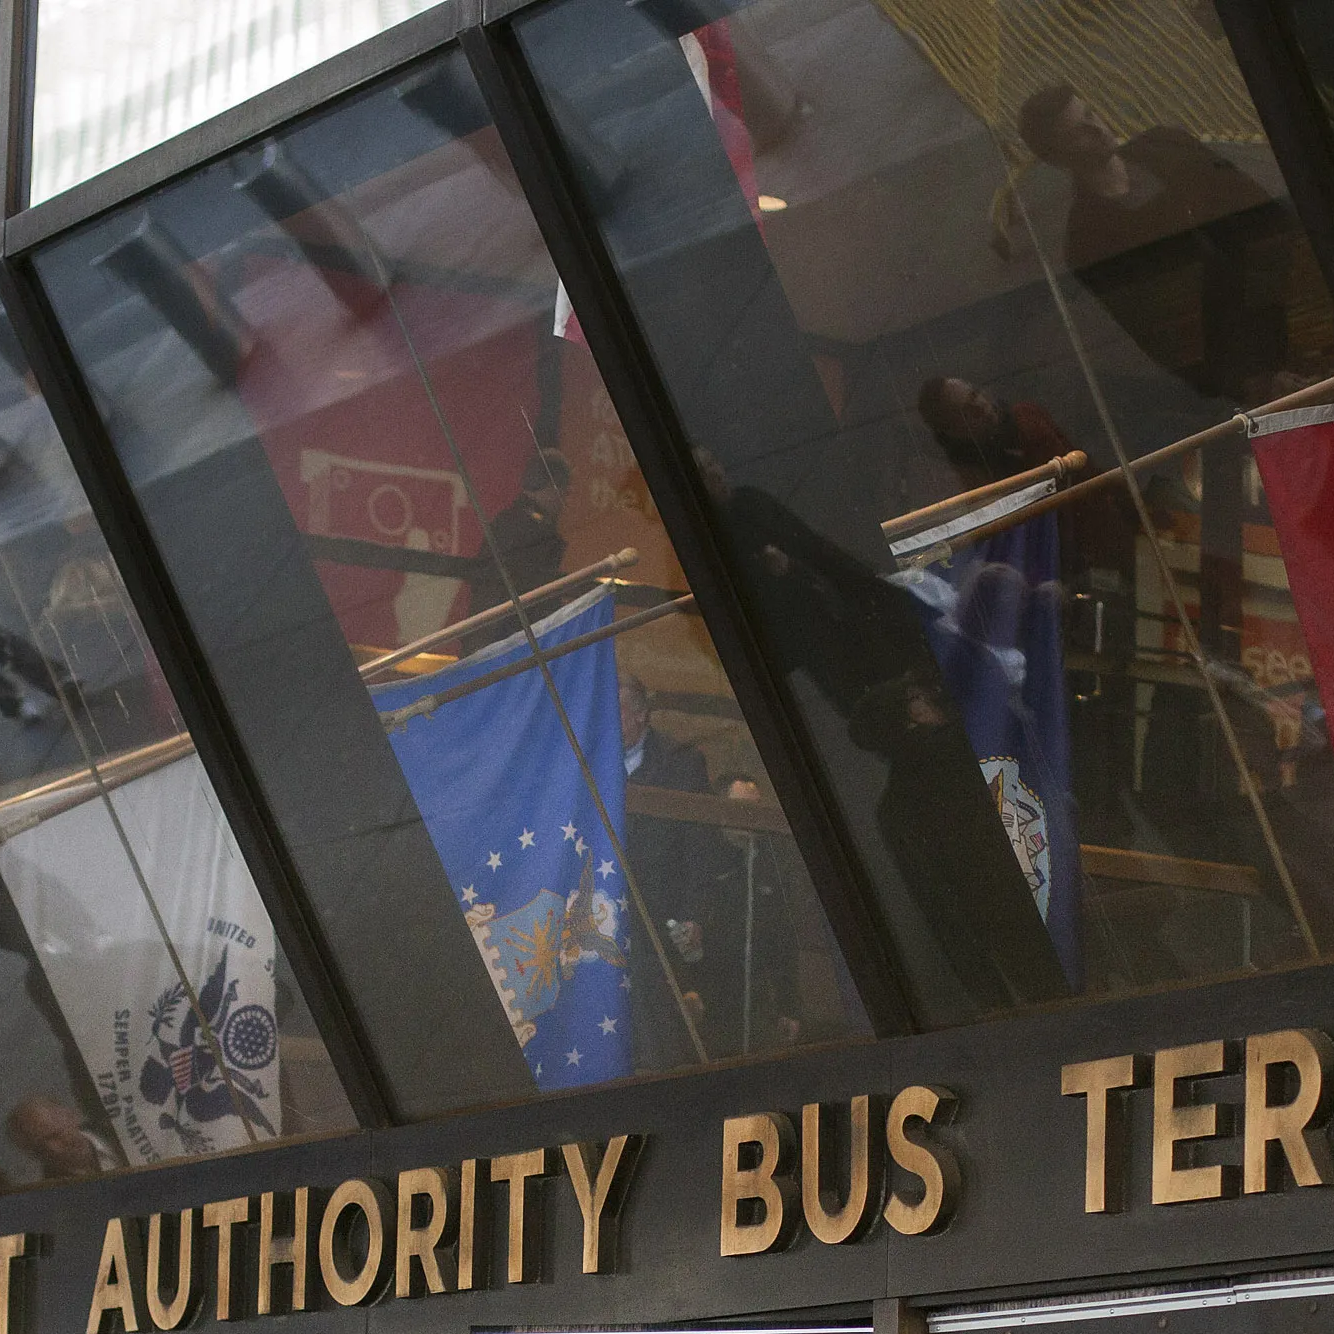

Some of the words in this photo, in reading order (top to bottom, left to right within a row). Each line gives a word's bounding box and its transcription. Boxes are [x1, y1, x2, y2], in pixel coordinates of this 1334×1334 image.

[206, 917, 257, 949] UNITED
[113, 1008, 132, 1083] SEMPER
[720, 1084, 949, 1257] BUS
